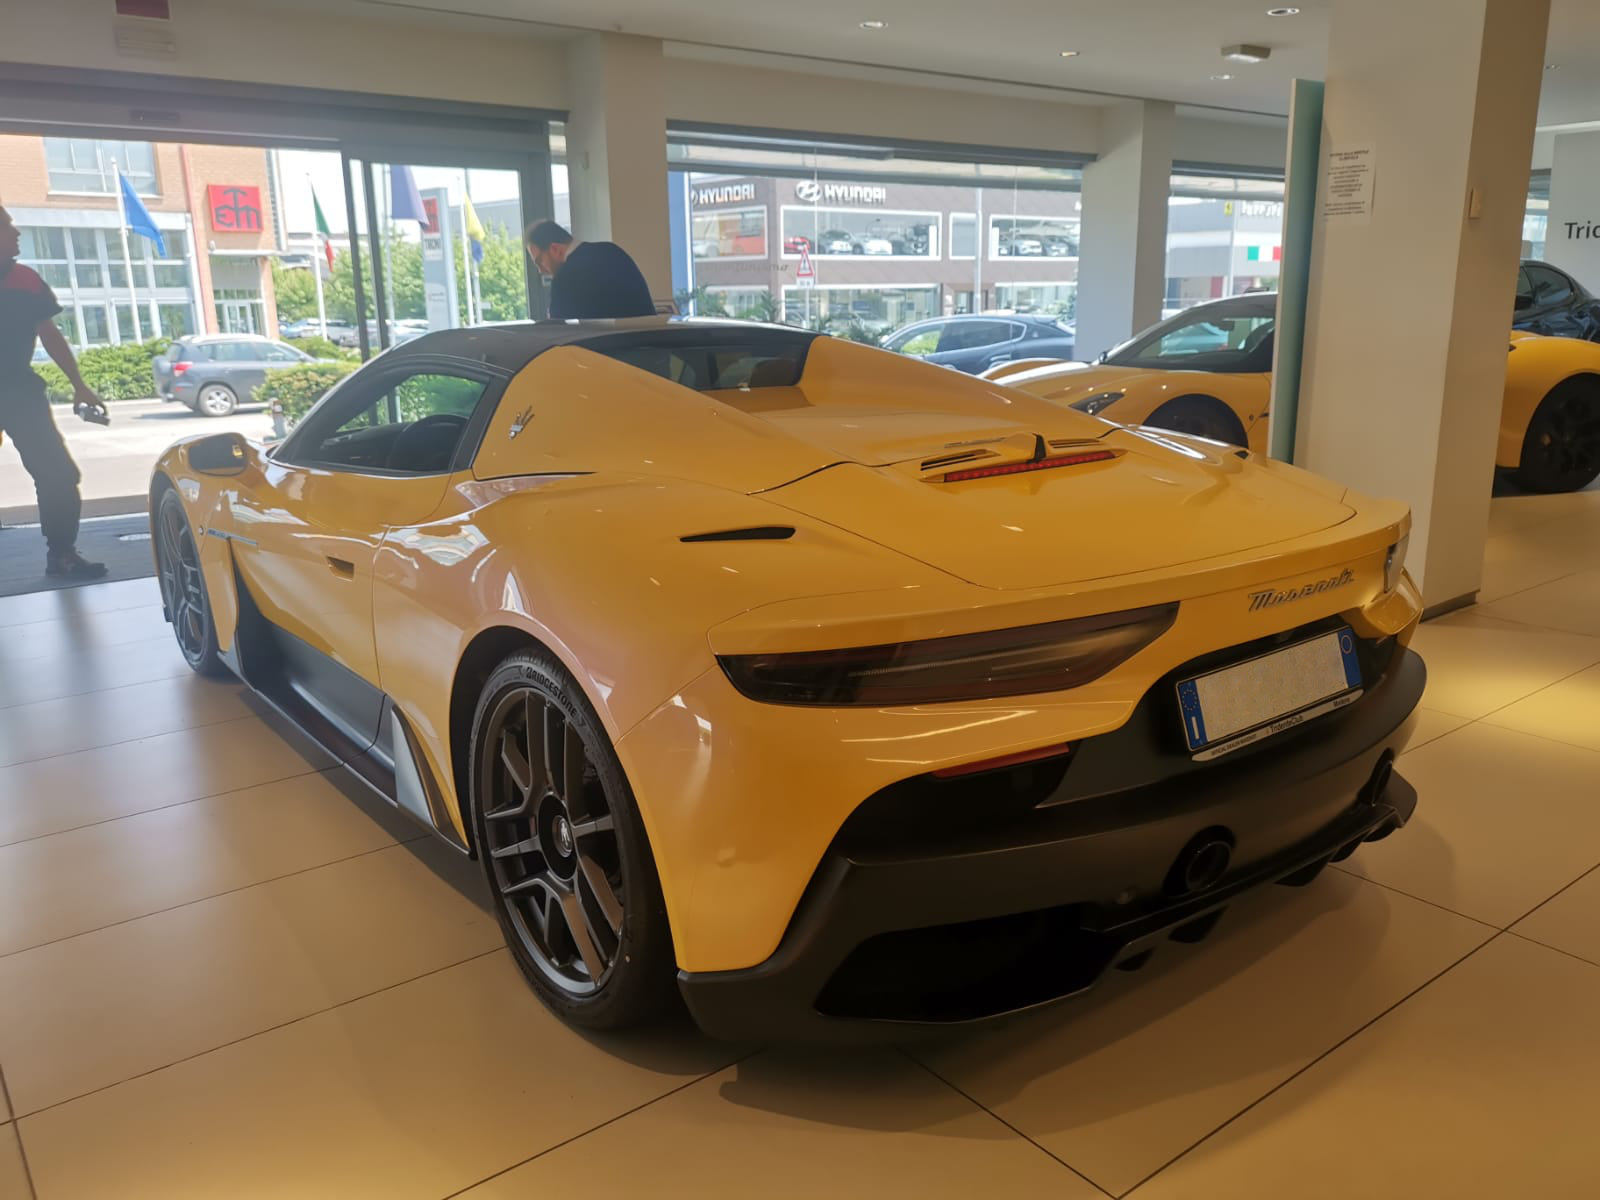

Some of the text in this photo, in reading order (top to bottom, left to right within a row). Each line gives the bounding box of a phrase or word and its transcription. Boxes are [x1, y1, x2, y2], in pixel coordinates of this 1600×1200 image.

[699, 183, 755, 204] HYUNDAI
[824, 183, 886, 203] HYUNDAI
[526, 666, 578, 718] BRIDGESTONE
